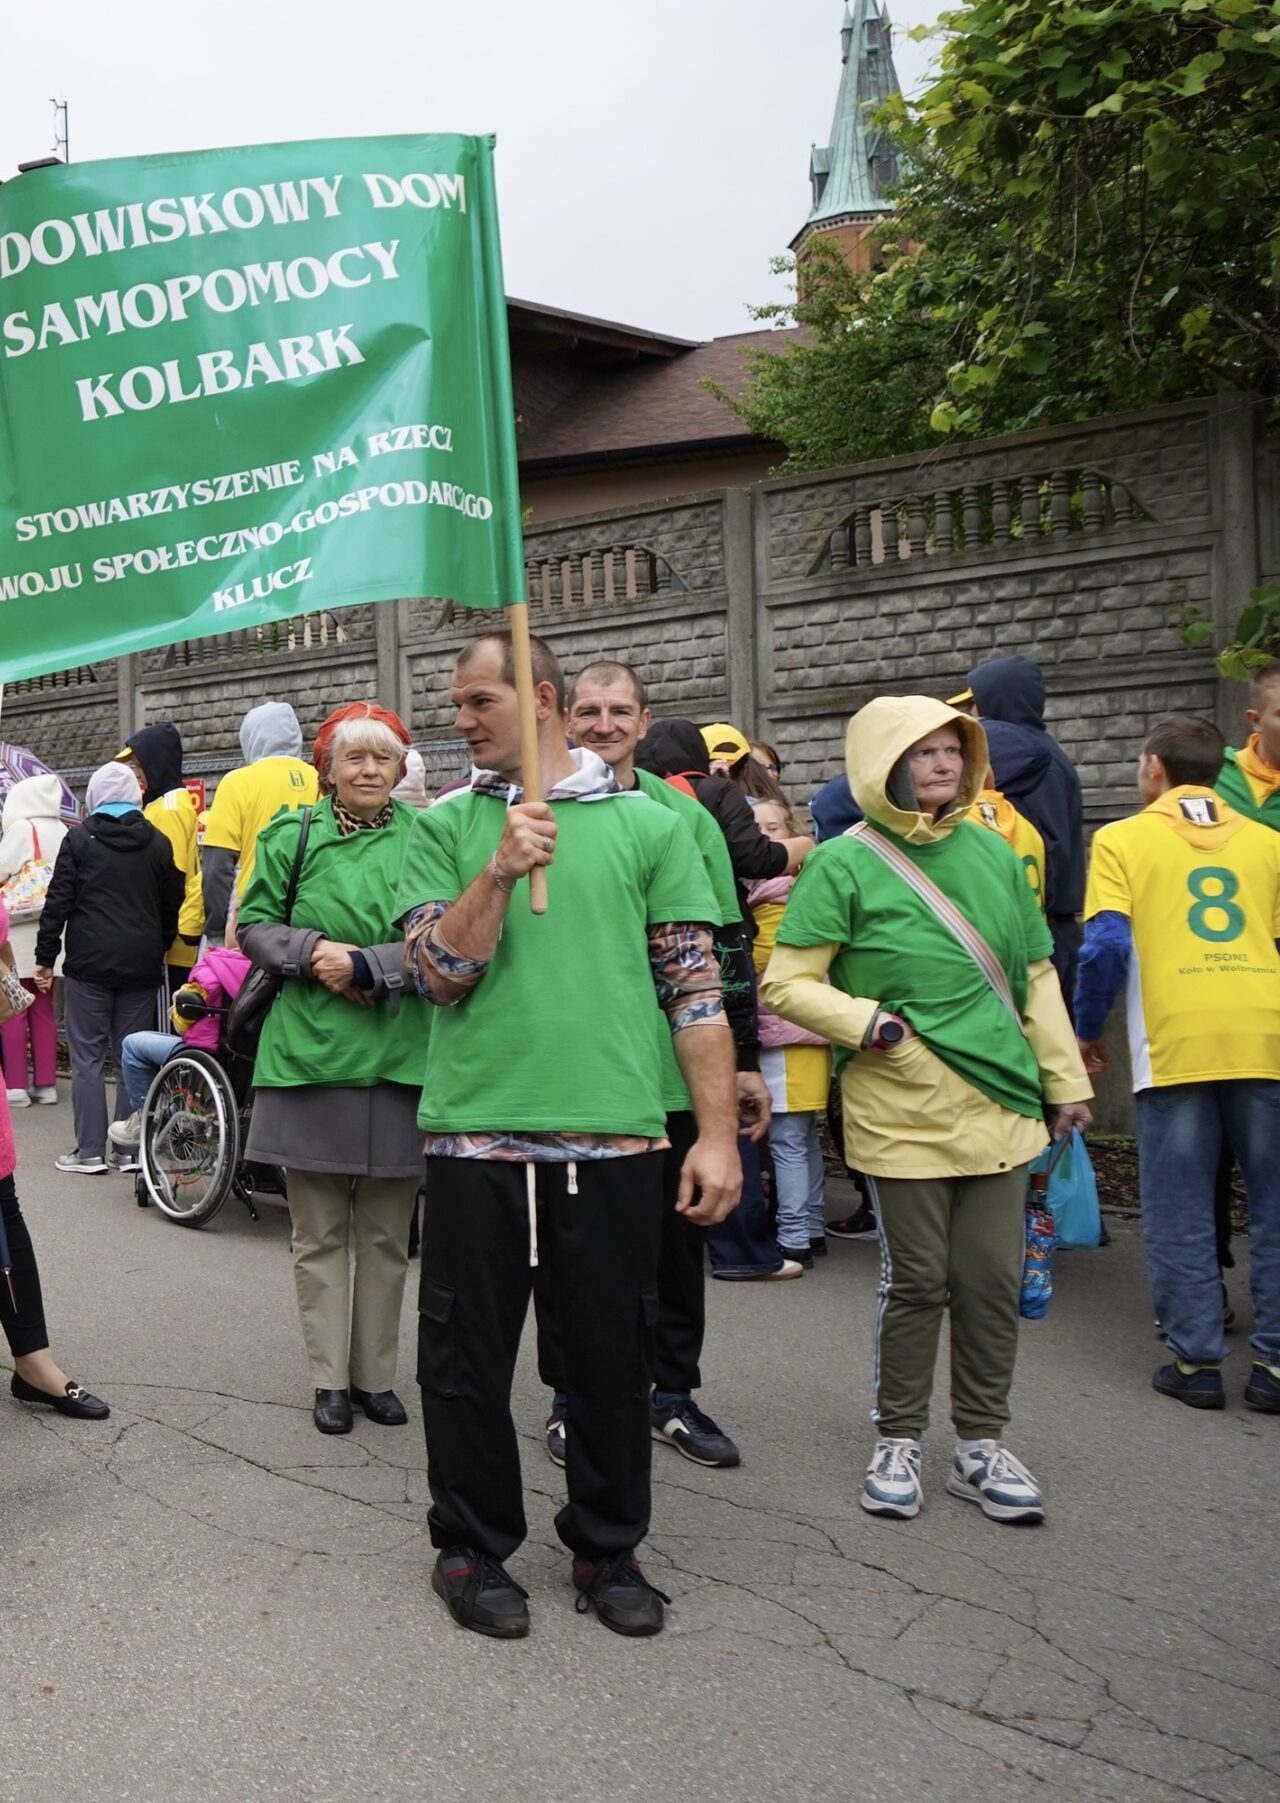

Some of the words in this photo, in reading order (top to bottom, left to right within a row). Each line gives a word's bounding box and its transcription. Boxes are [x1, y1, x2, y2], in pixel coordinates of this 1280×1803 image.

[361, 172, 466, 215] DOM
[1, 239, 401, 359] SAMOPOMOCY
[74, 322, 366, 422] KOLBARK
[14, 459, 305, 542] STOWARZYSZENIE
[312, 446, 359, 479] NA
[367, 423, 454, 458] RZECZ
[92, 480, 494, 584] SPOŁECZNO-GOSPODARCGO
[212, 557, 315, 613] KLUCZ
[1188, 866, 1246, 942] 8
[1204, 953, 1248, 961] PSONI
